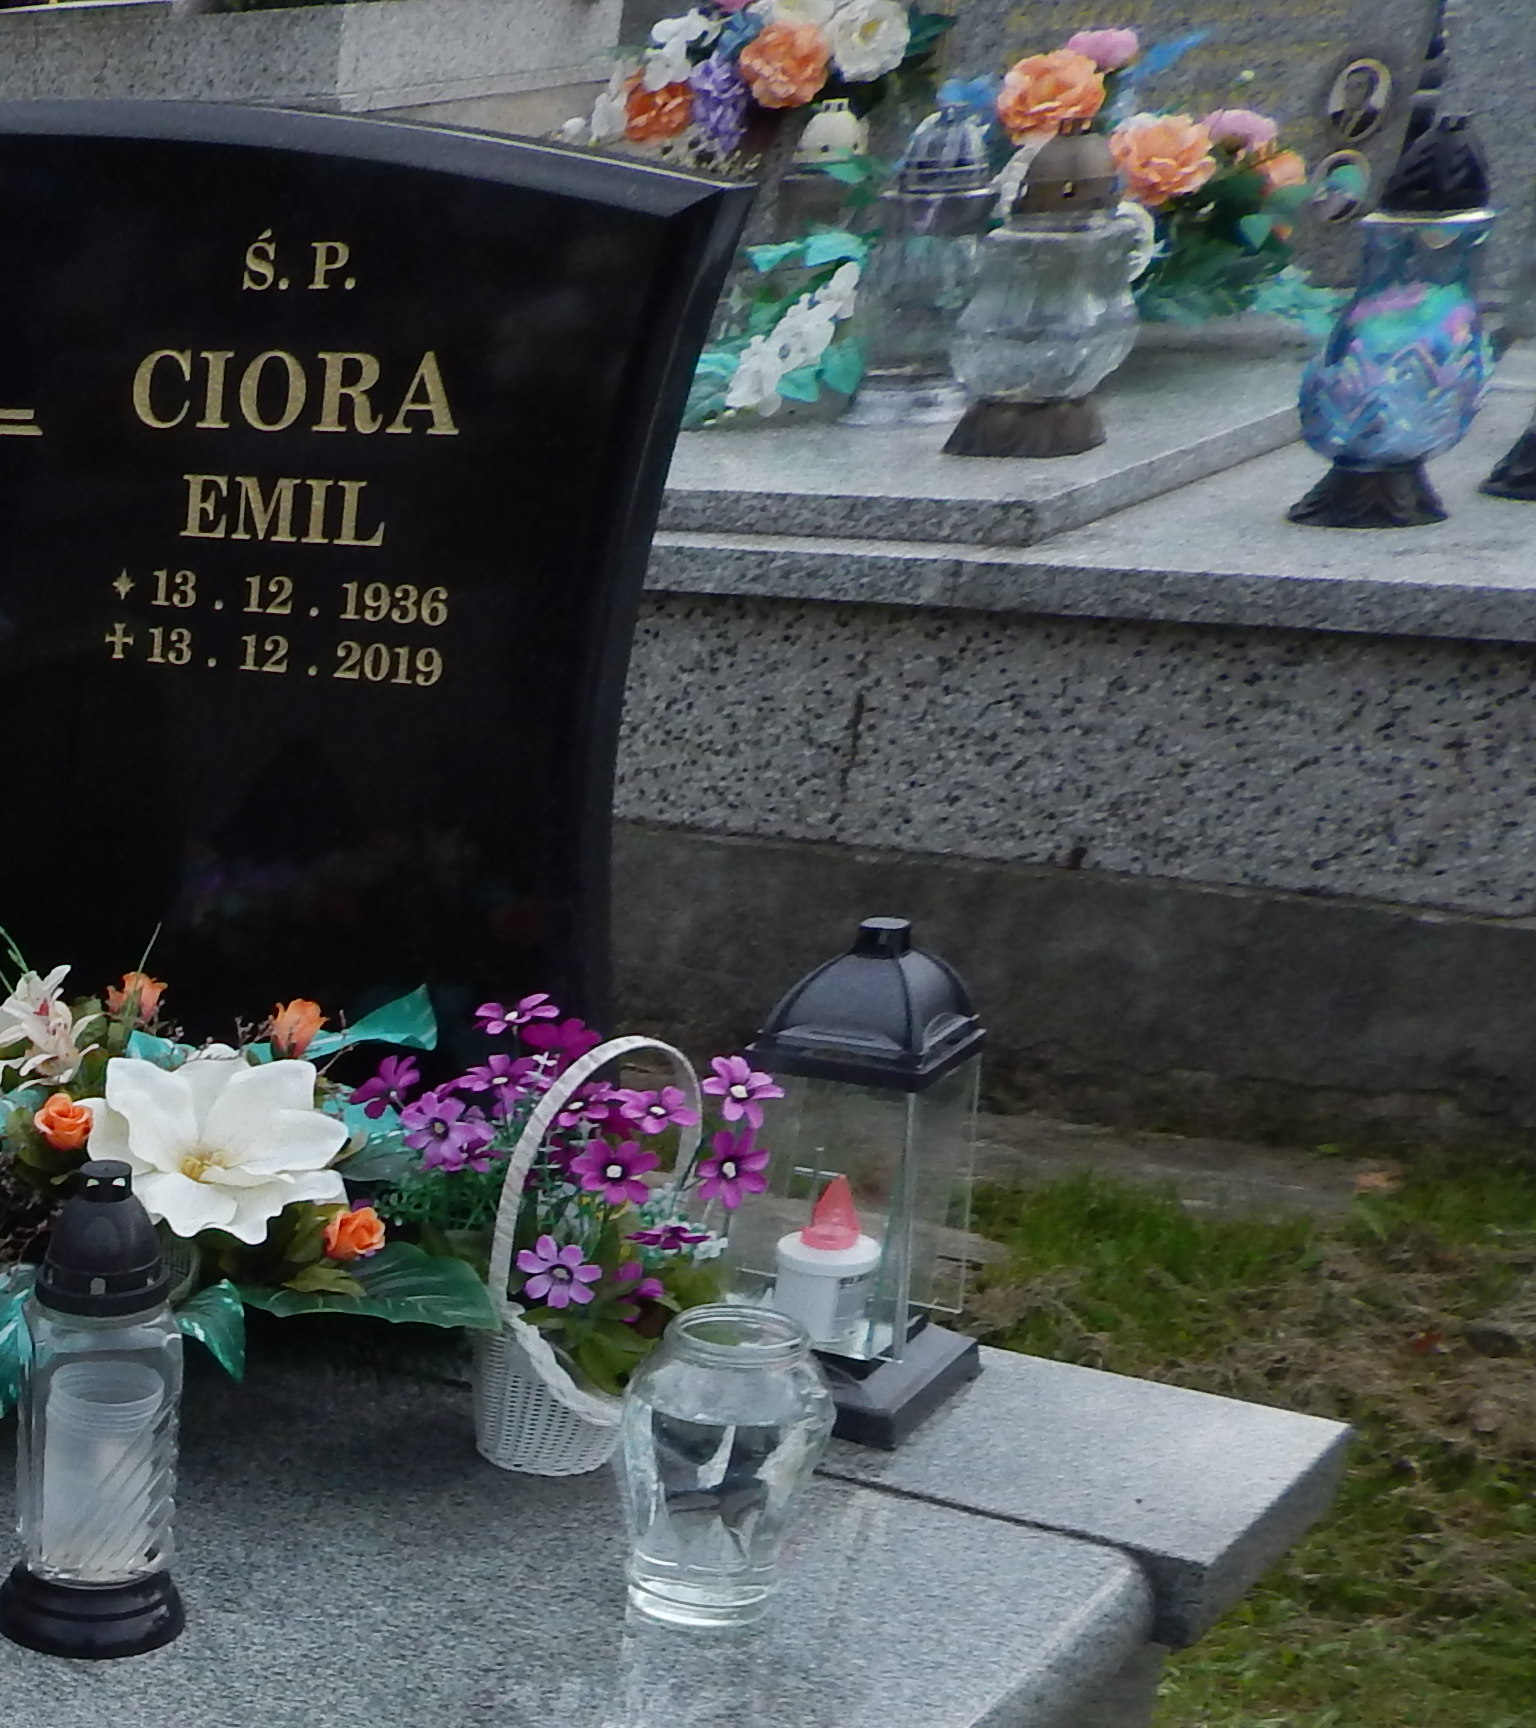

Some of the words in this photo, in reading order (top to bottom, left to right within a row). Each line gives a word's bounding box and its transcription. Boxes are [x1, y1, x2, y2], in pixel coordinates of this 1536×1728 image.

[243, 228, 289, 290] Ś.
[308, 241, 356, 290] P.
[133, 349, 459, 435] CIORA
[179, 474, 385, 547] EMIL
